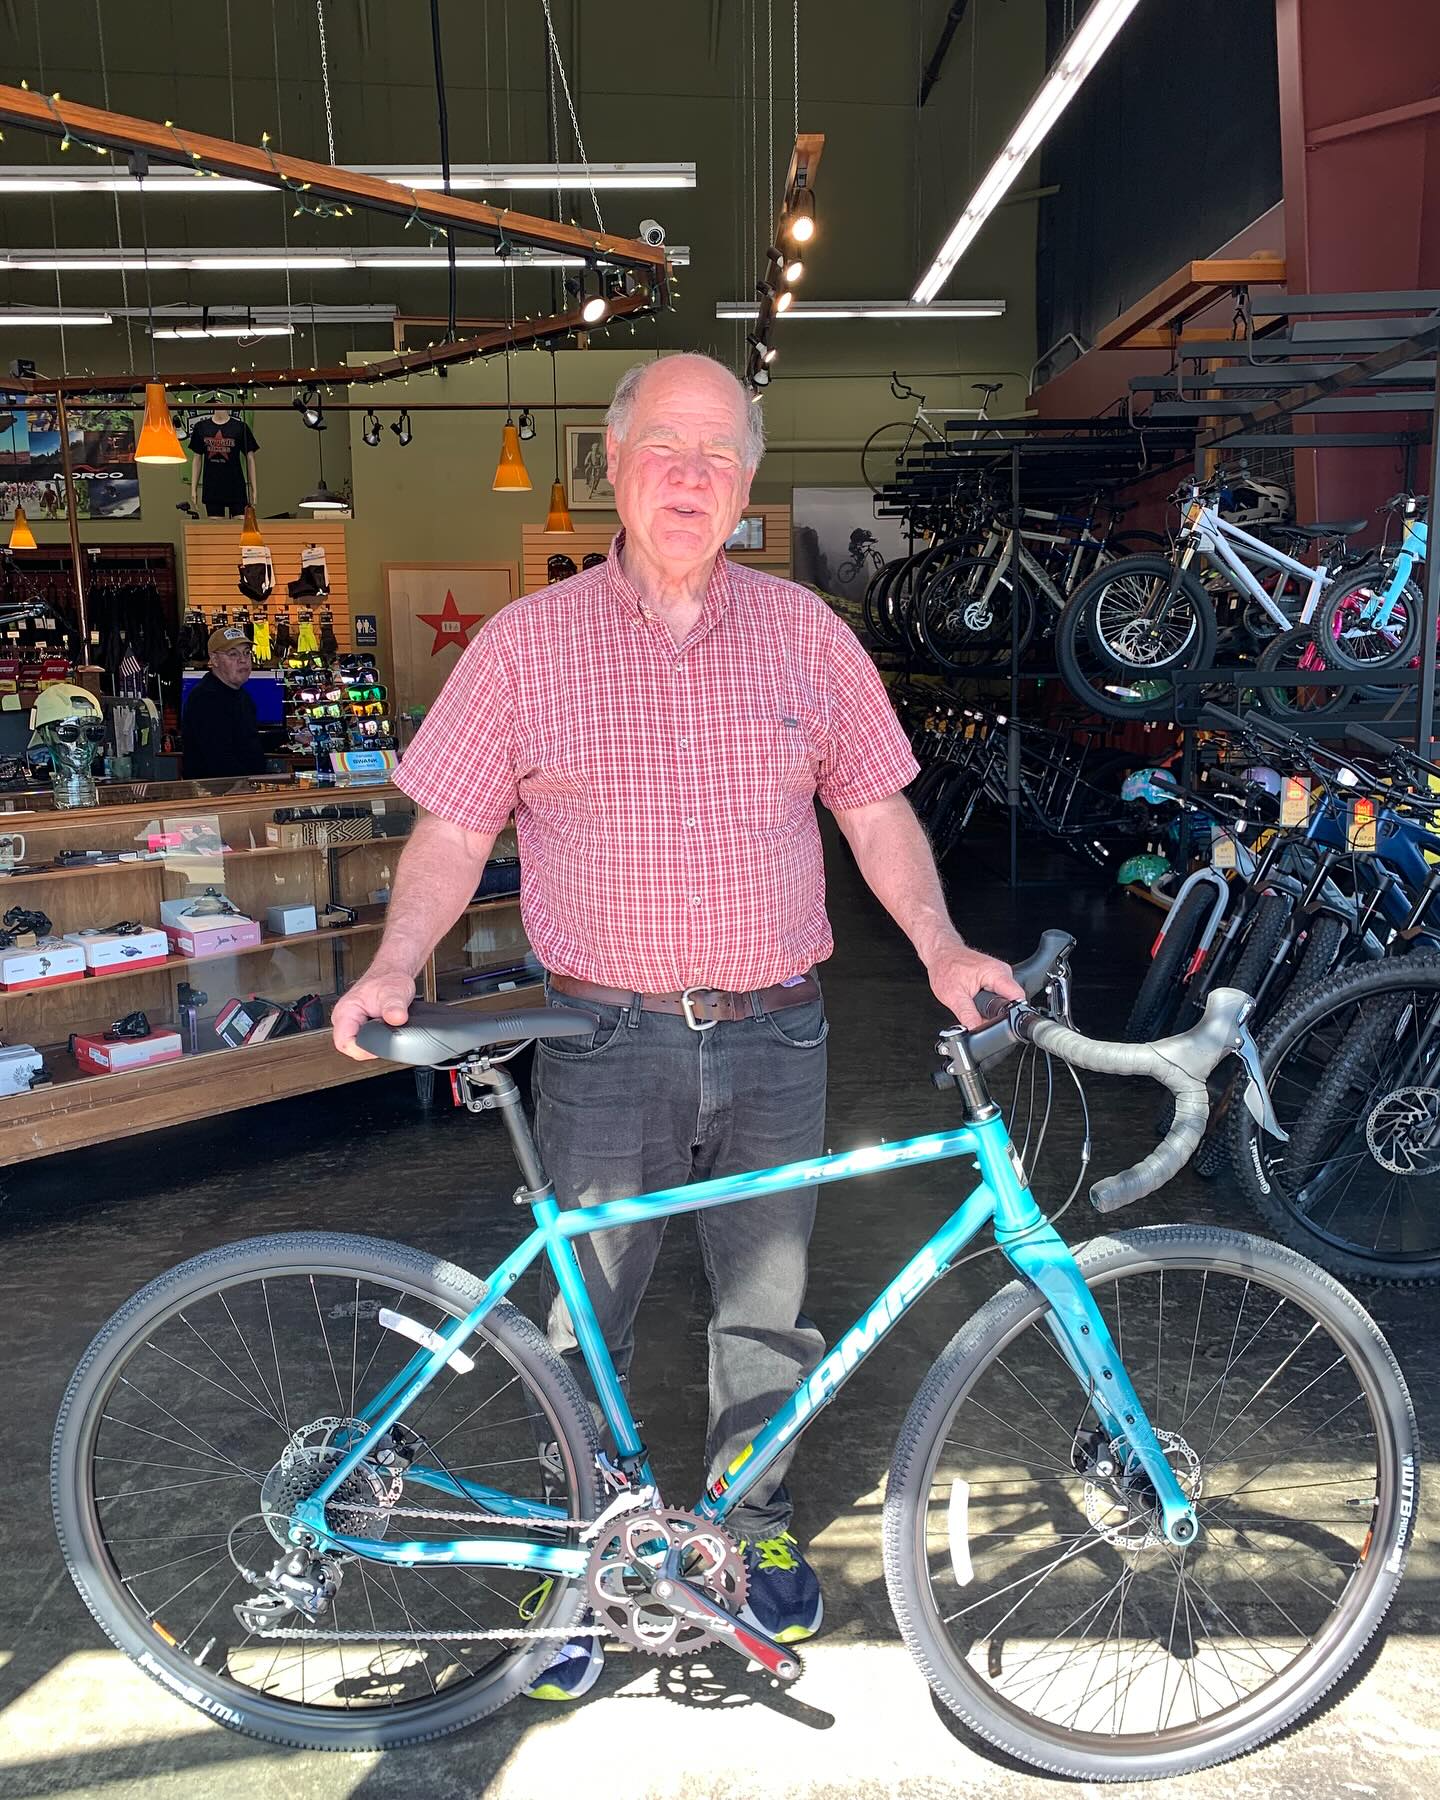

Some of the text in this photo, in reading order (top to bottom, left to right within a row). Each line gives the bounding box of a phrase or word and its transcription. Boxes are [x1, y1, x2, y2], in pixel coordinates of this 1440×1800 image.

[53, 472, 124, 480] NORCO
[1249, 1145, 1271, 1195] Continental
[777, 1247, 938, 1443] JAMIS
[1399, 1465, 1415, 1519] WTB
